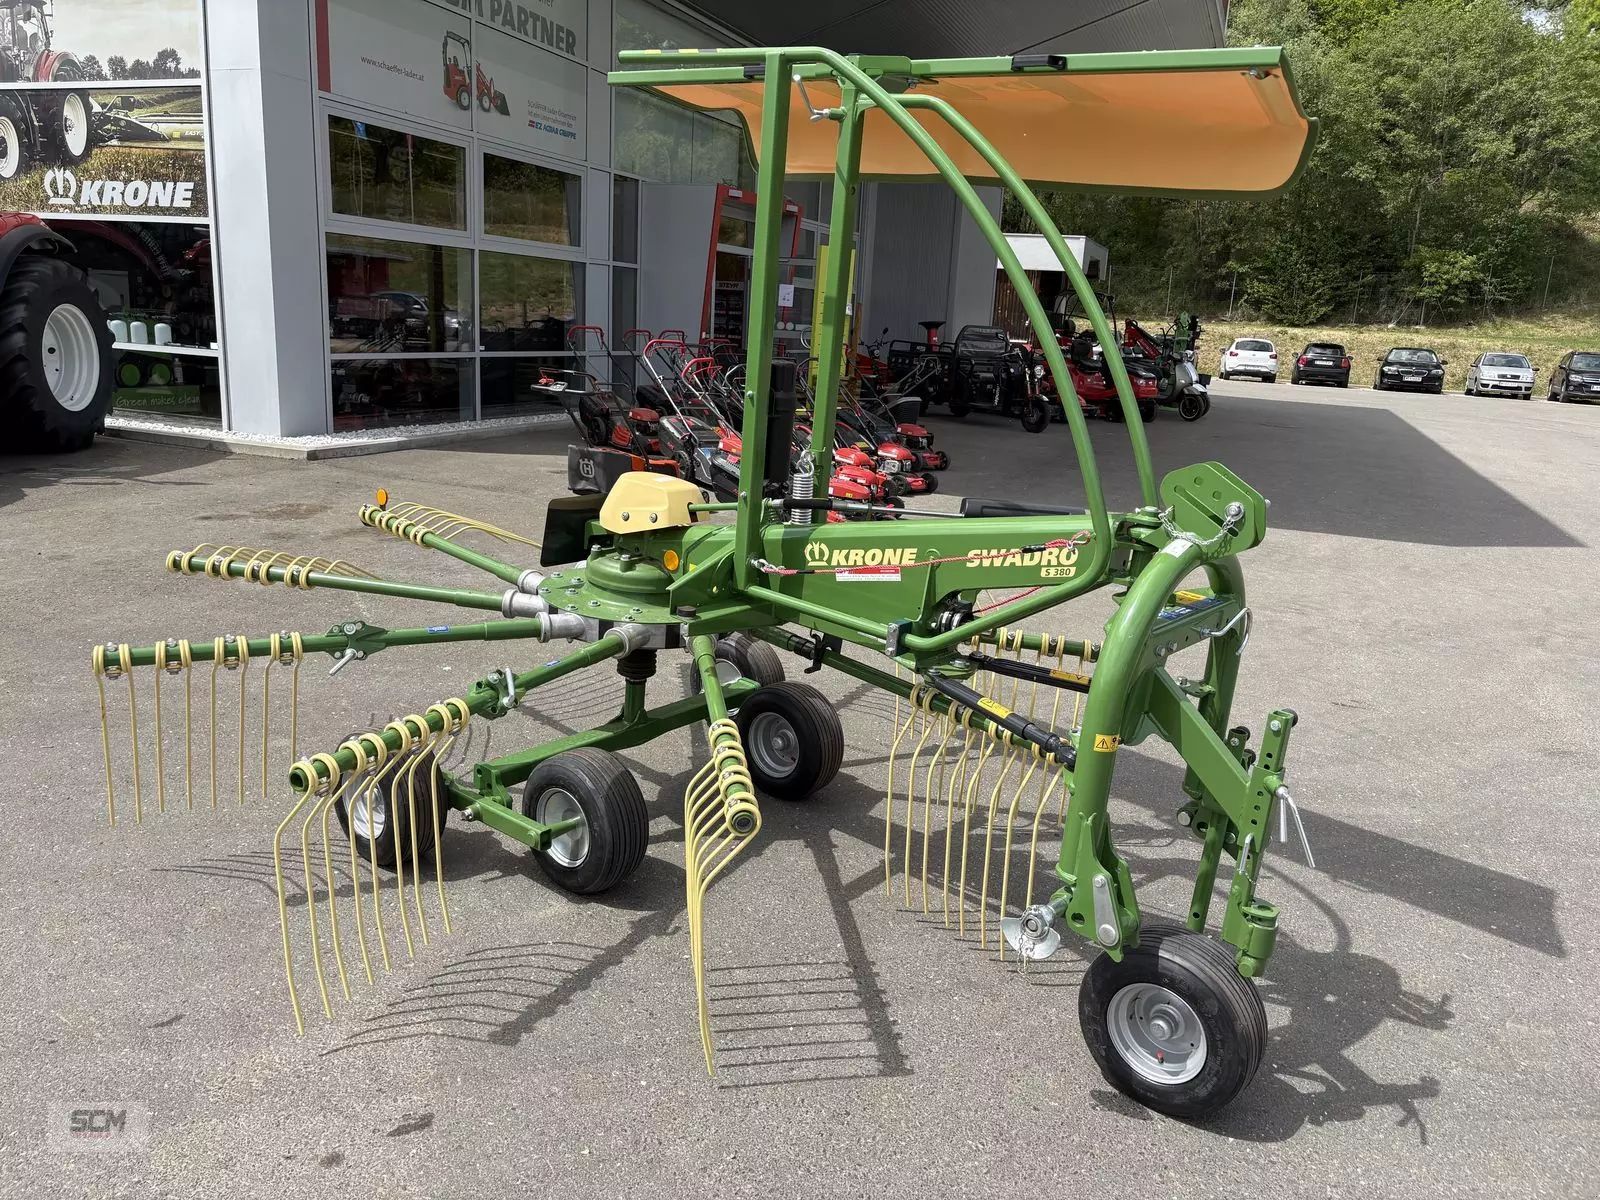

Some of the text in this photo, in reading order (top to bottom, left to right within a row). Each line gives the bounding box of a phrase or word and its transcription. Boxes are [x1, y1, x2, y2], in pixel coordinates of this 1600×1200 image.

[489, 0, 577, 56] PARTNER
[80, 180, 194, 208] KRONE
[831, 548, 1079, 567] KRONE SWADRO
[1045, 568, 1071, 577] S 380
